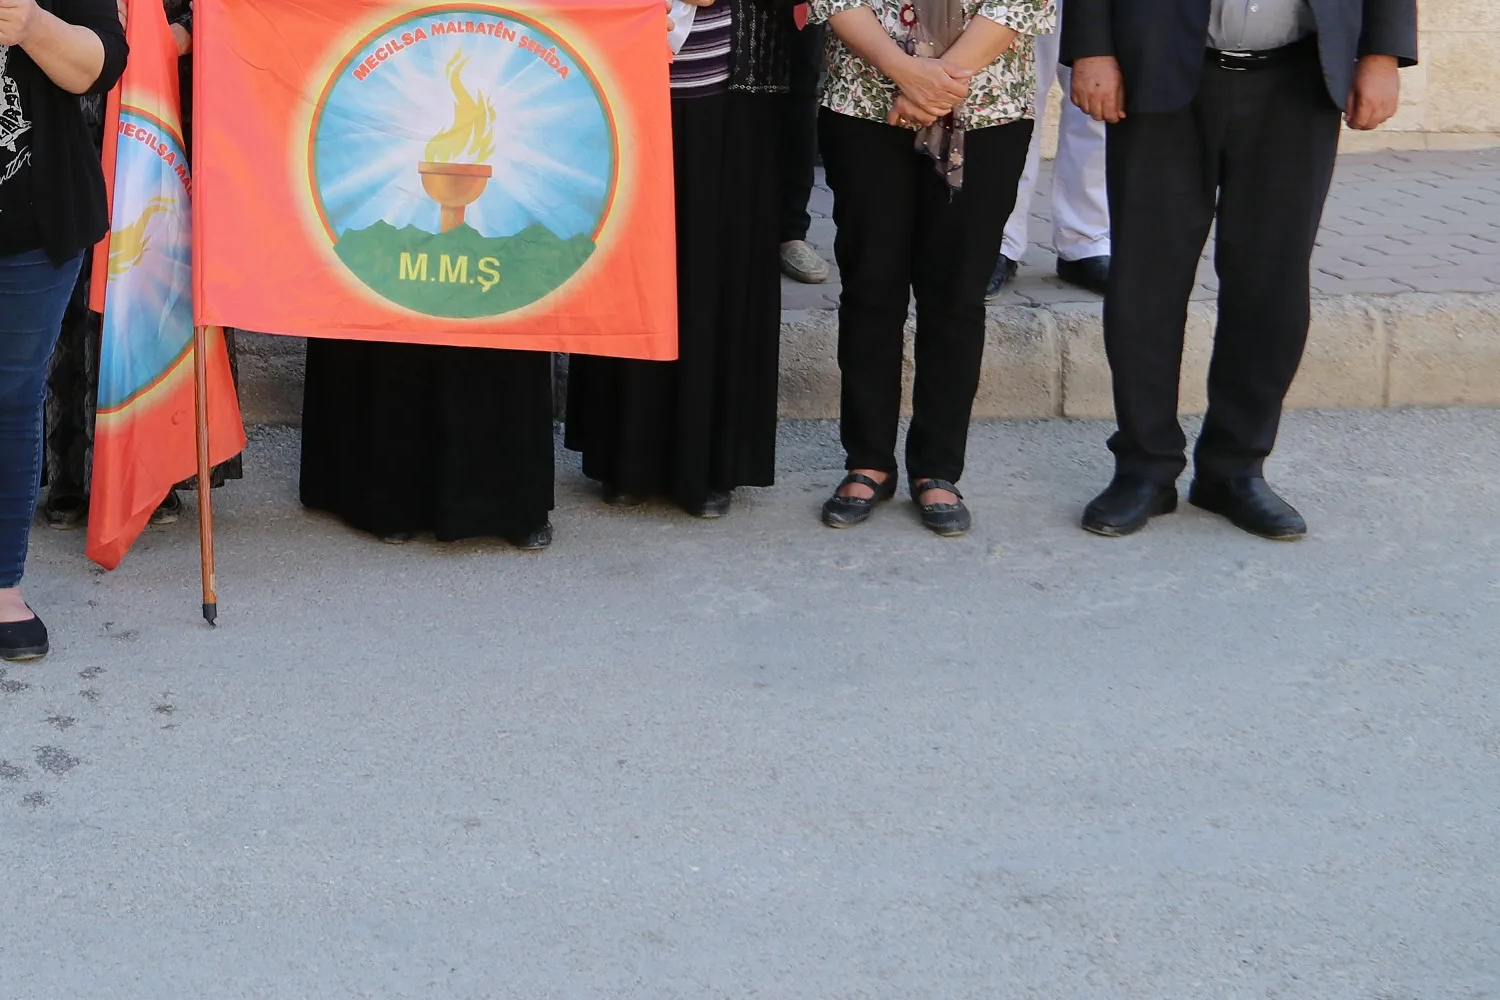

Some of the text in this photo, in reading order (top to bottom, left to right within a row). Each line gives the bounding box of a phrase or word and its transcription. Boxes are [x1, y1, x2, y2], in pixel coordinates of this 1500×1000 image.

[352, 27, 428, 82] MECILSA
[431, 20, 516, 43] MALBATÊN
[399, 251, 501, 293] M.M.Ş
